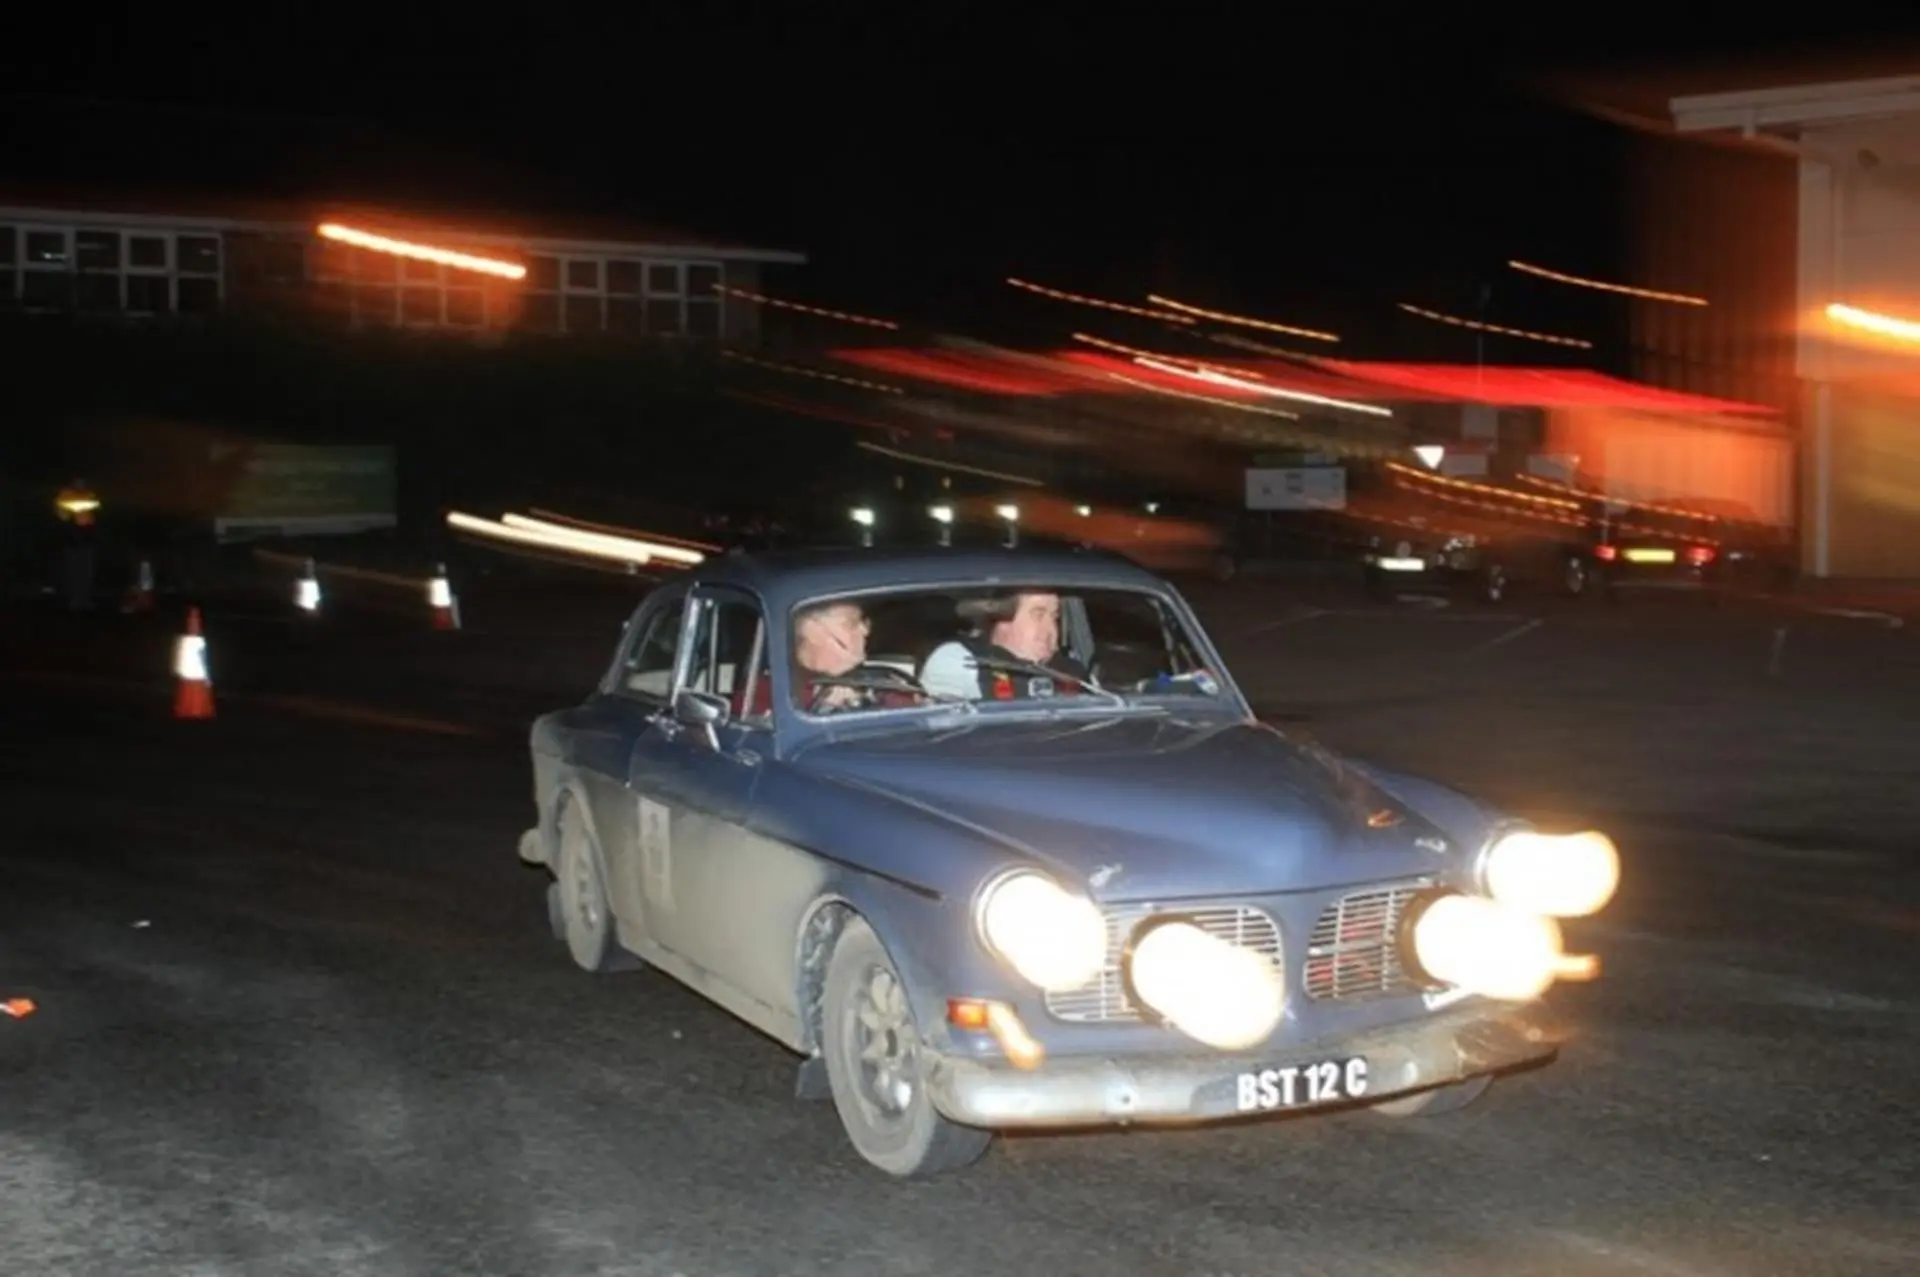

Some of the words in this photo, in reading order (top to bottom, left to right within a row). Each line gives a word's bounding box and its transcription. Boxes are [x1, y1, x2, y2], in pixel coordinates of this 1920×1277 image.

[1237, 1067, 1299, 1111] BST
[1304, 1061, 1340, 1101] 12
[1345, 1057, 1367, 1097] C
